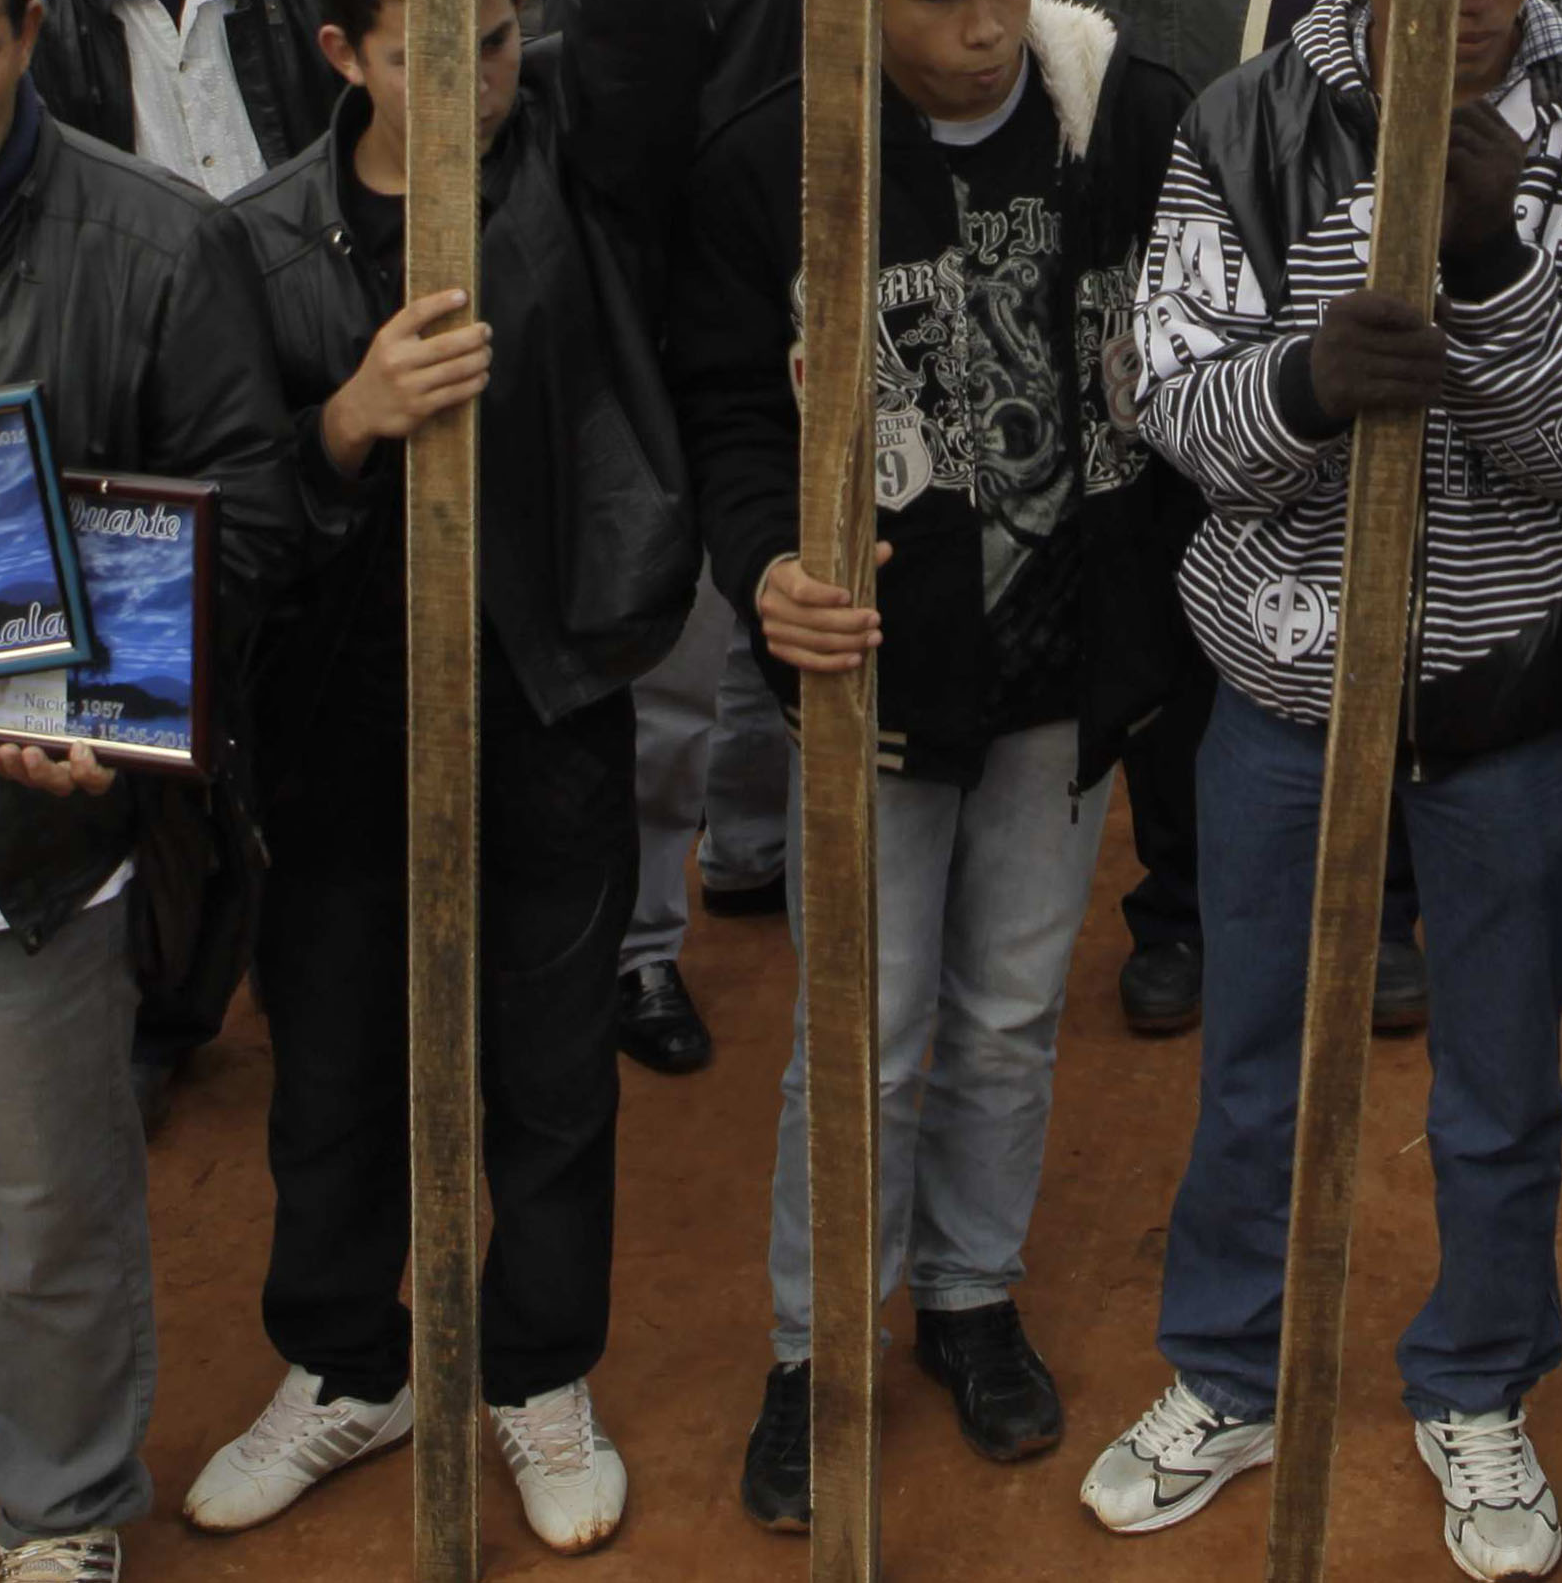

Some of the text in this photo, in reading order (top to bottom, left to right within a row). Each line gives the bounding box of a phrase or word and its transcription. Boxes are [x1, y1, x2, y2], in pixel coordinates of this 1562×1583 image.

[876, 417, 915, 433] TURE
[876, 430, 906, 447] IRL
[81, 698, 125, 720] 1957
[98, 722, 191, 750] 15-06-201
